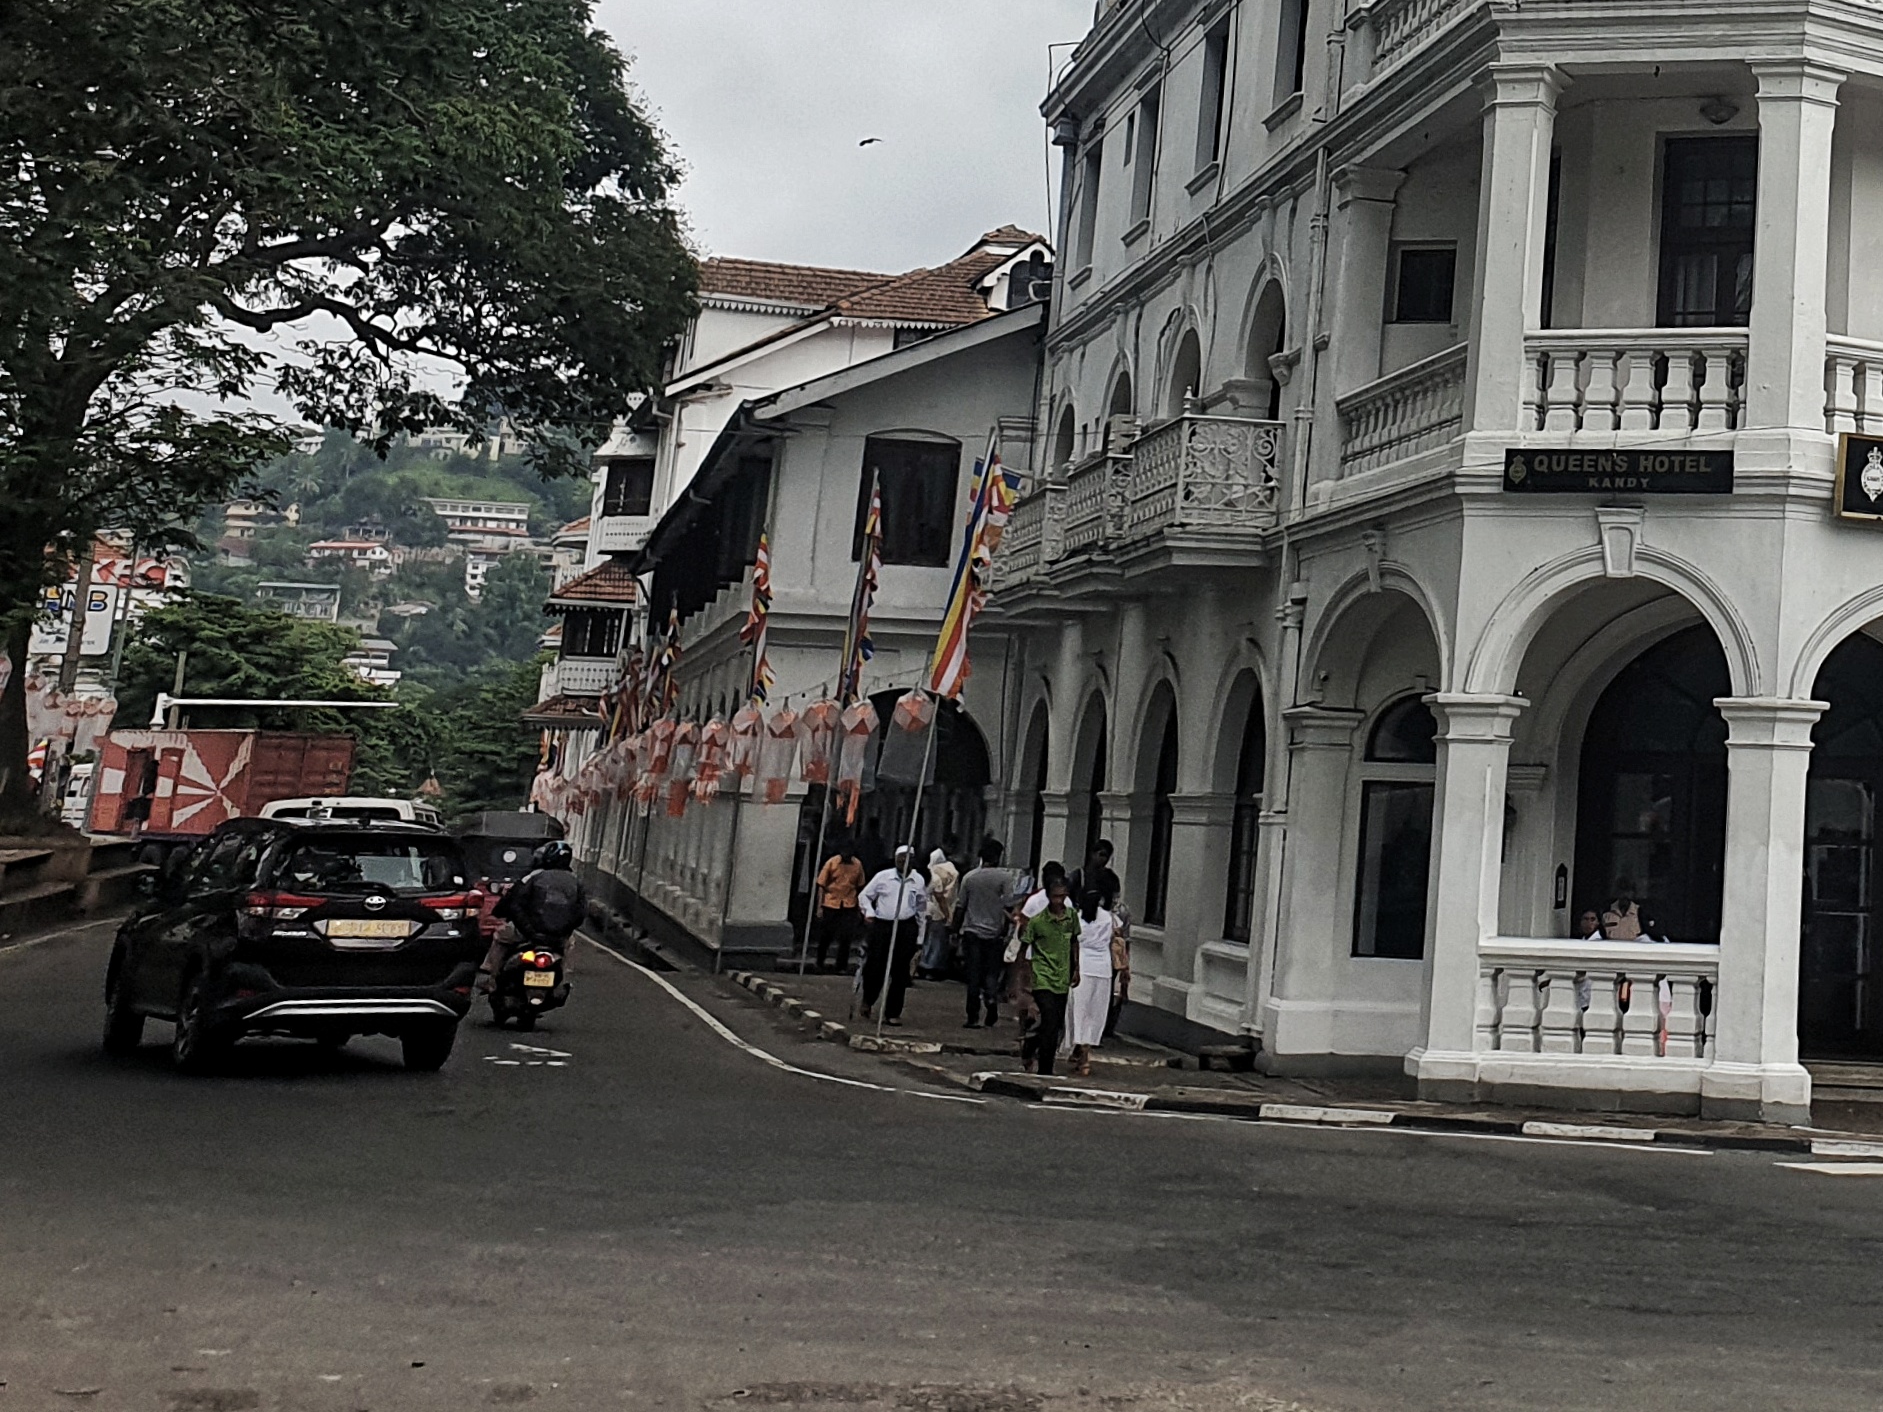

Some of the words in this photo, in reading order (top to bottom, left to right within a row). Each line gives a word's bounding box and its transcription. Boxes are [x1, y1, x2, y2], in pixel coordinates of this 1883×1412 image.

[1534, 453, 1629, 473] QUEEN'S
[1638, 455, 1713, 473] HOTEL
[1588, 477, 1651, 488] KANDY
